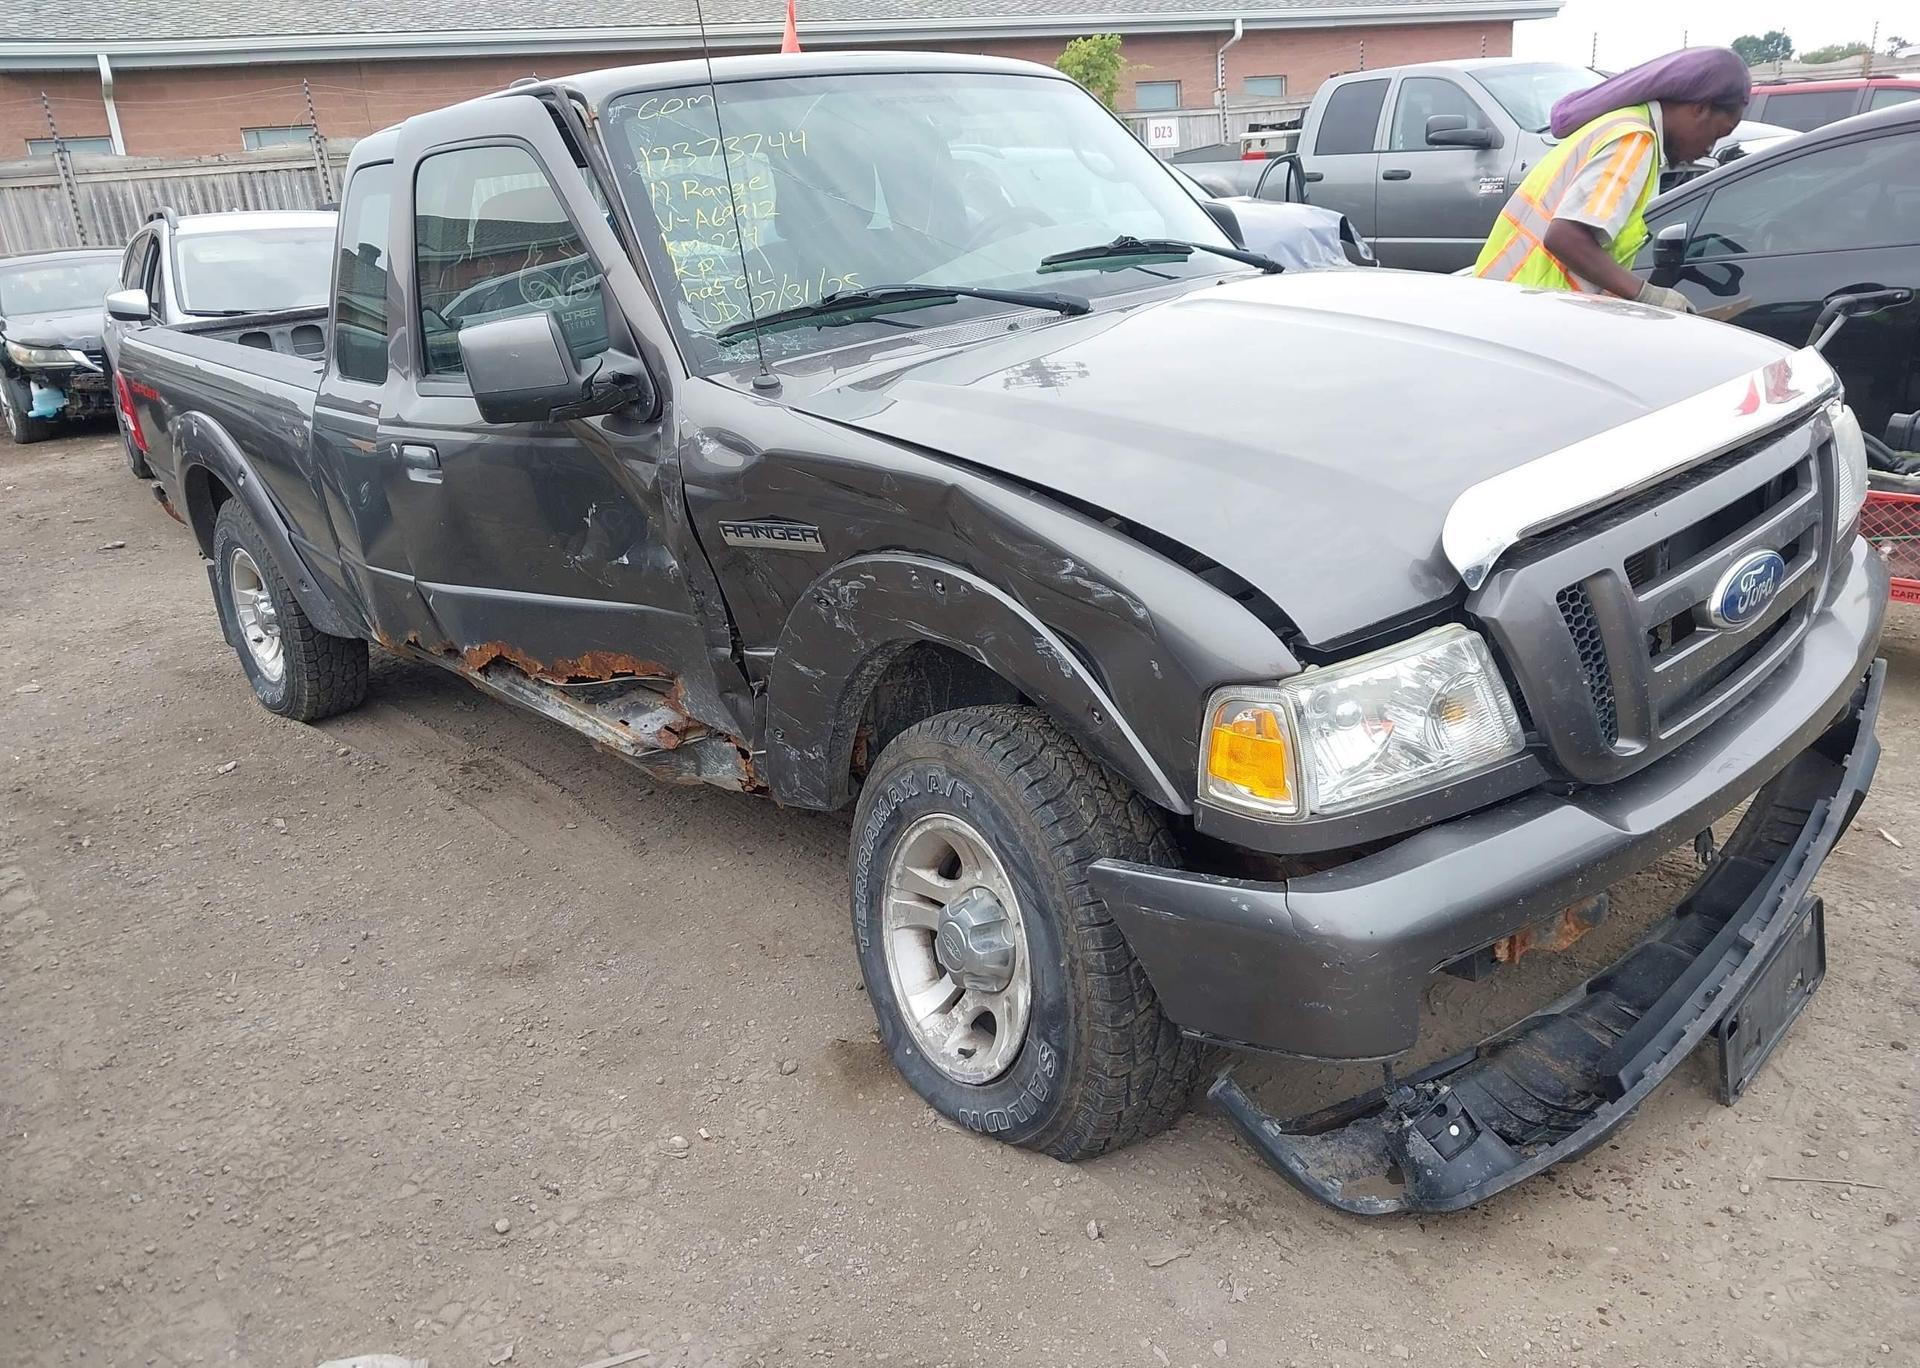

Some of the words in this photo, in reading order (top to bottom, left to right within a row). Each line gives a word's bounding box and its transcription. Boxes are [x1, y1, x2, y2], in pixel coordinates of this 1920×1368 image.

[720, 524, 820, 543] RANGER
[1737, 563, 1776, 614] Ford
[855, 771, 920, 953] TERRAMAX
[926, 771, 975, 809] A/T
[958, 1042, 1057, 1133] SAILUN
